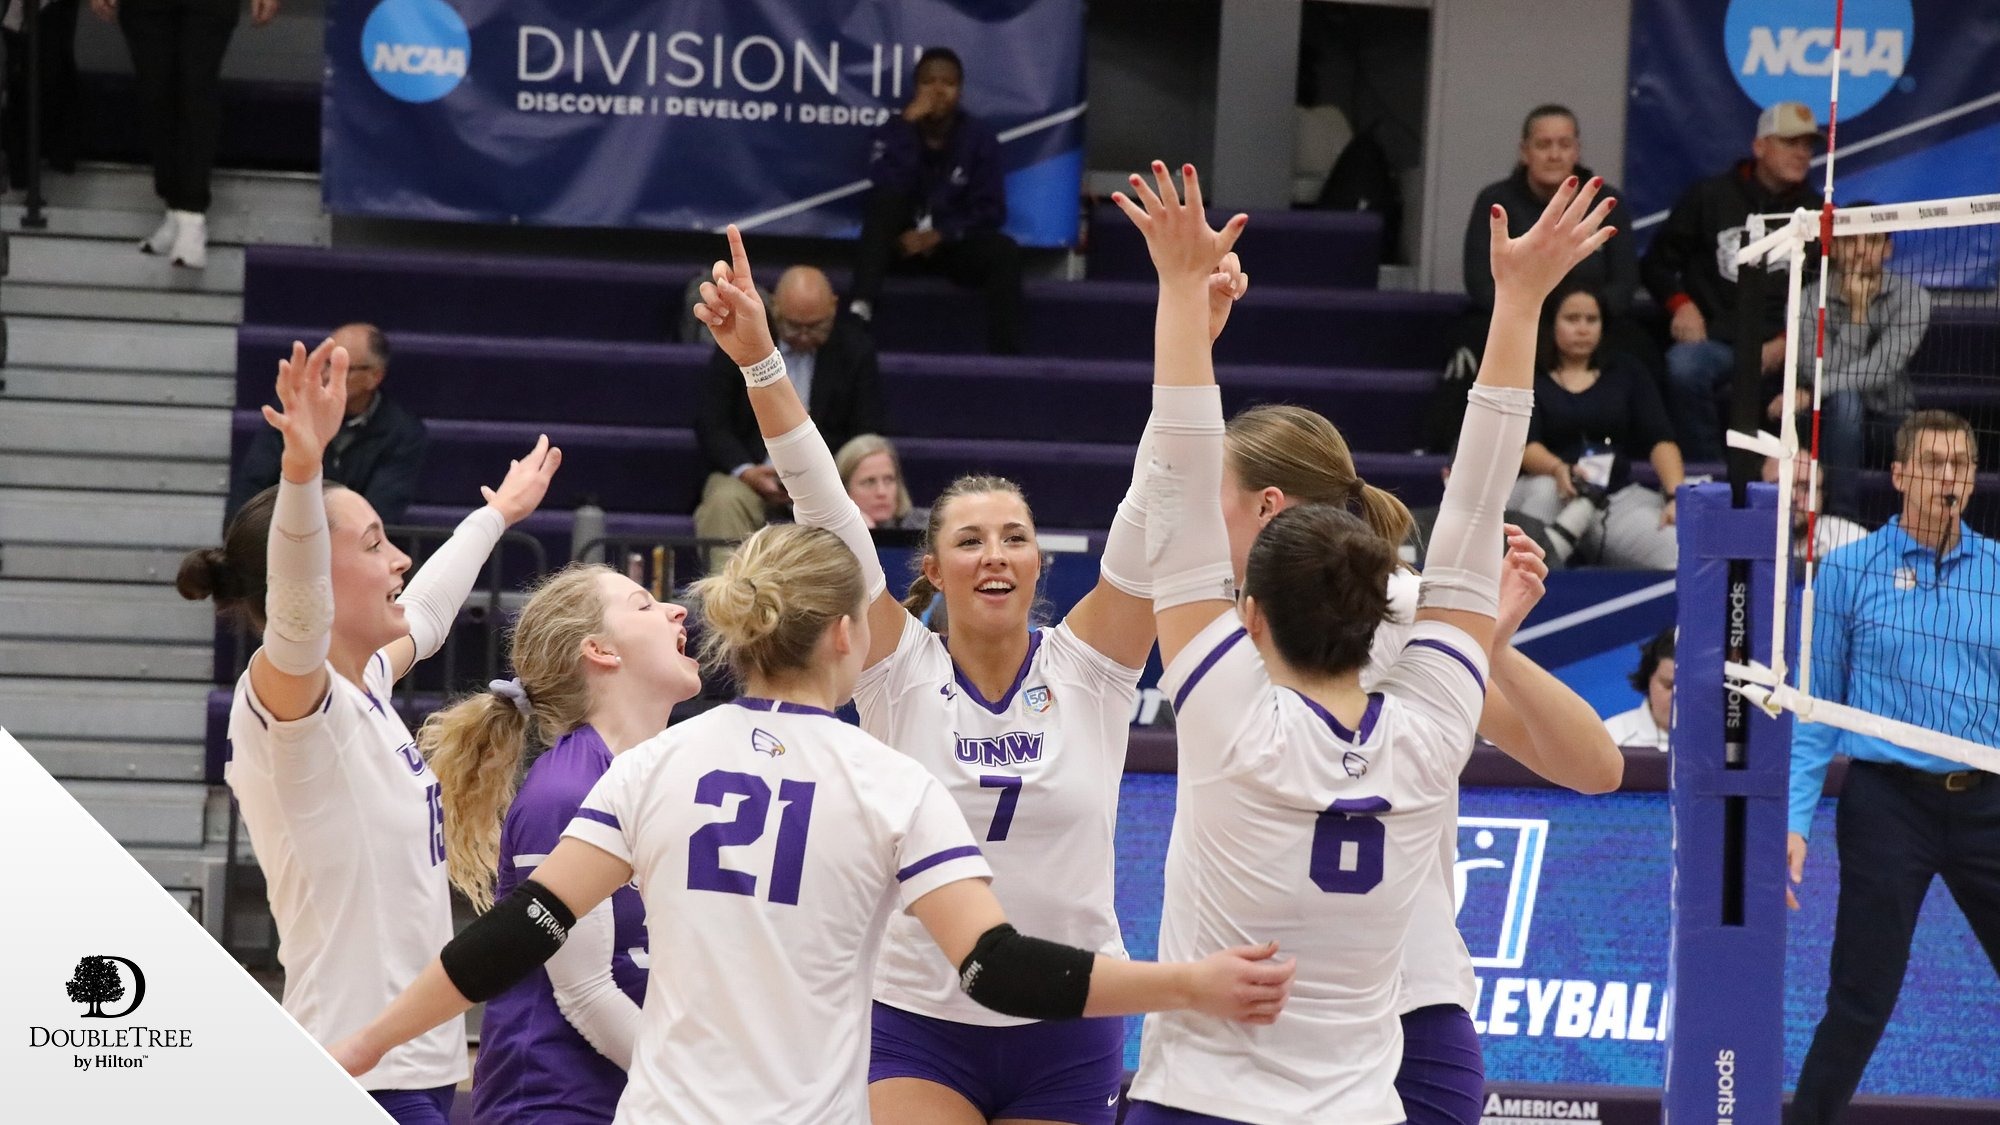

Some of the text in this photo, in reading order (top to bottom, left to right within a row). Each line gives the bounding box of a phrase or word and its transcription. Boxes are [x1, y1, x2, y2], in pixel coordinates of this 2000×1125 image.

[373, 42, 467, 78] NCAA
[517, 25, 838, 96] DIVISION
[1742, 27, 1904, 78] NCAA
[517, 91, 644, 116] DISCOVER
[665, 98, 778, 122] DEVELOP
[801, 102, 902, 127] DEDICA
[1729, 582, 1746, 647] sports
[1030, 691, 1047, 705] 50
[1727, 660, 1744, 728] ports
[954, 731, 1044, 767] UNW
[687, 769, 816, 906] 21
[980, 775, 1022, 842] 7
[1309, 795, 1392, 894] 6
[1470, 976, 1668, 1042] LEYBAL
[1483, 1093, 1599, 1119] AMERICAN
[1715, 1049, 1736, 1115] sports
